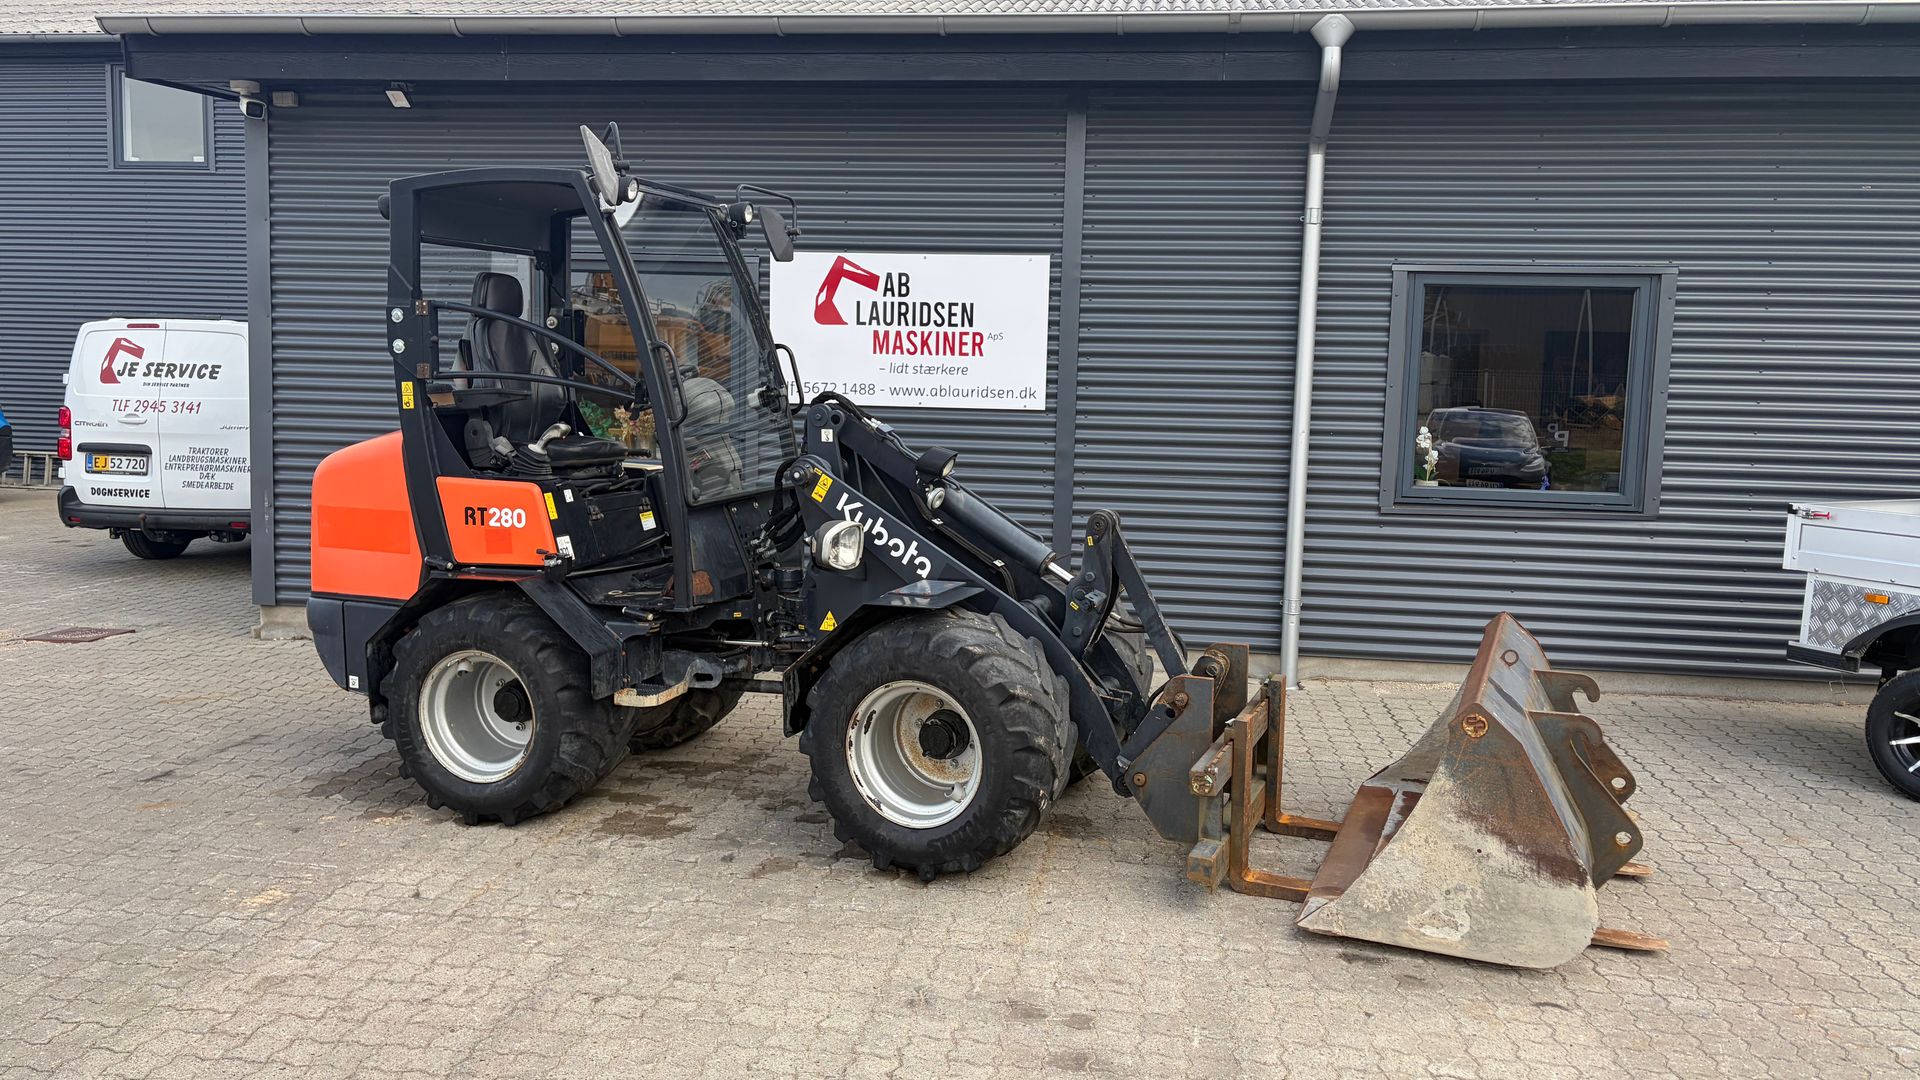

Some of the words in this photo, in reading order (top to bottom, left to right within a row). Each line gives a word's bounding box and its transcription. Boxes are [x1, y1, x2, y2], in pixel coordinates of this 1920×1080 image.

[883, 272, 910, 297] AB
[856, 301, 974, 327] LAURIDSEN
[873, 330, 984, 357] MASKINER
[987, 332, 1004, 341] ApS
[117, 362, 139, 377] JE
[143, 362, 222, 380] SERVICE
[889, 363, 909, 375] lidt
[912, 364, 969, 376] stærkere
[842, 383, 876, 395] 1488
[889, 383, 1037, 400] www.ablauridsen.dk
[112, 400, 130, 412] TLF
[134, 400, 166, 413] 2945
[171, 401, 201, 414] 3141
[188, 447, 229, 456] TRAKTORER
[94, 457, 108, 468] EJ
[109, 458, 123, 469] 52
[125, 459, 146, 470] 720
[168, 455, 247, 465] LANDBRUGSMASKINER
[182, 481, 234, 490] SMEDEARBEJDE
[464, 506, 526, 528] RT280
[835, 491, 932, 579] Kubota
